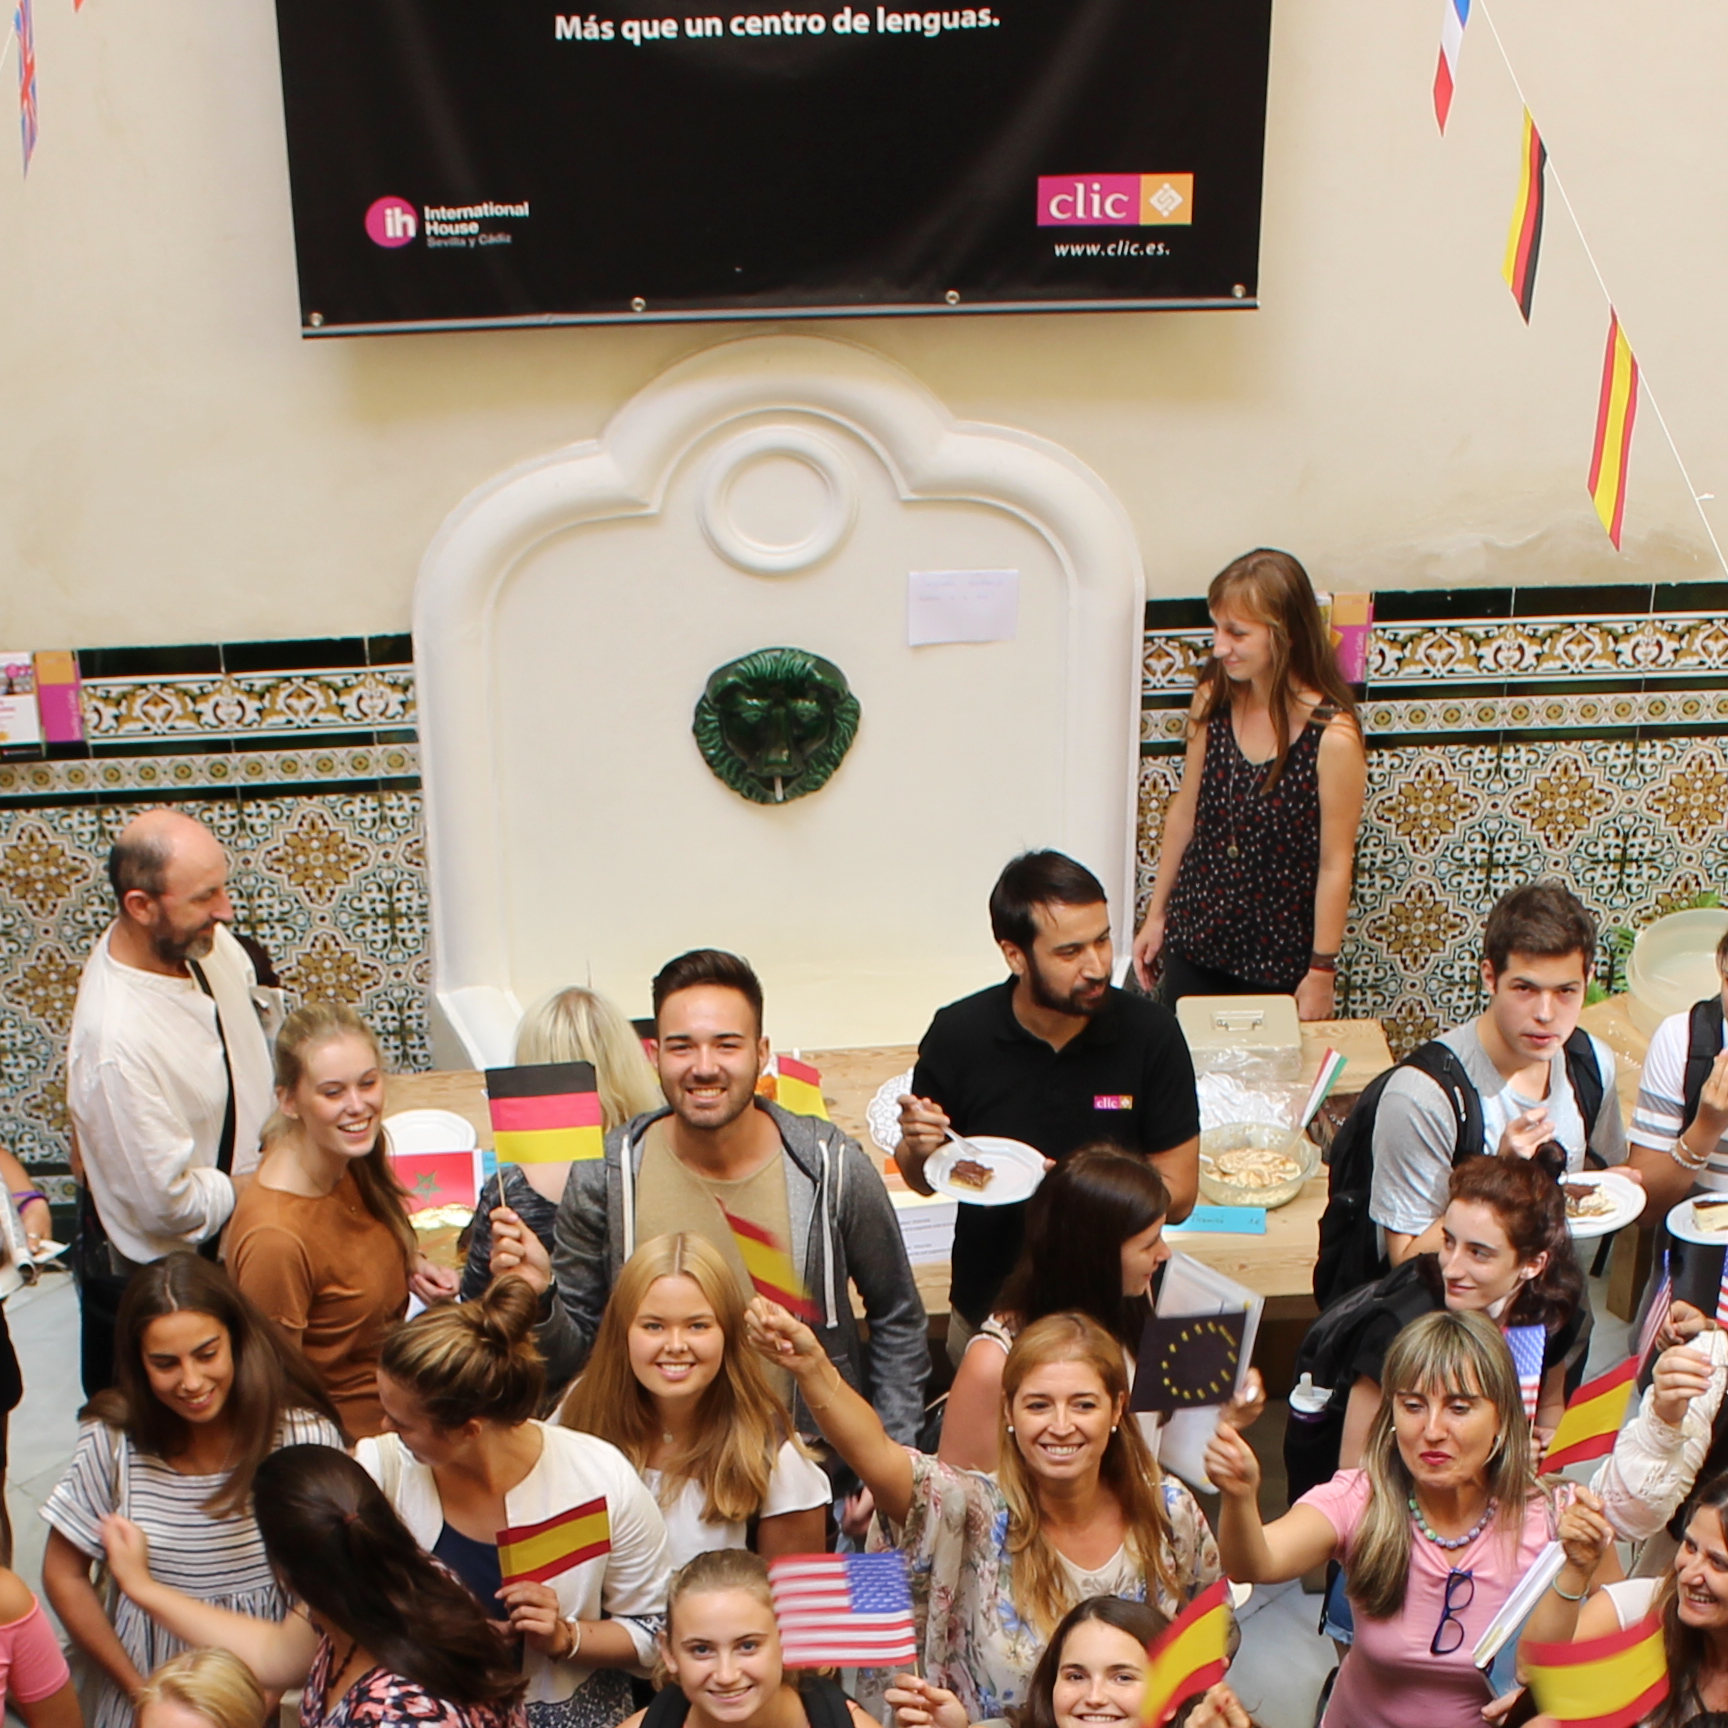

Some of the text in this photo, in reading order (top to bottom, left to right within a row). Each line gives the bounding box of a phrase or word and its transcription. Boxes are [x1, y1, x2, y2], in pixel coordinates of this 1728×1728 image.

[554, 7, 1000, 46] Más que un centro de lenguas.
[424, 201, 529, 221] International
[1049, 182, 1130, 220] clic
[384, 206, 417, 238] ih
[425, 221, 480, 236] House
